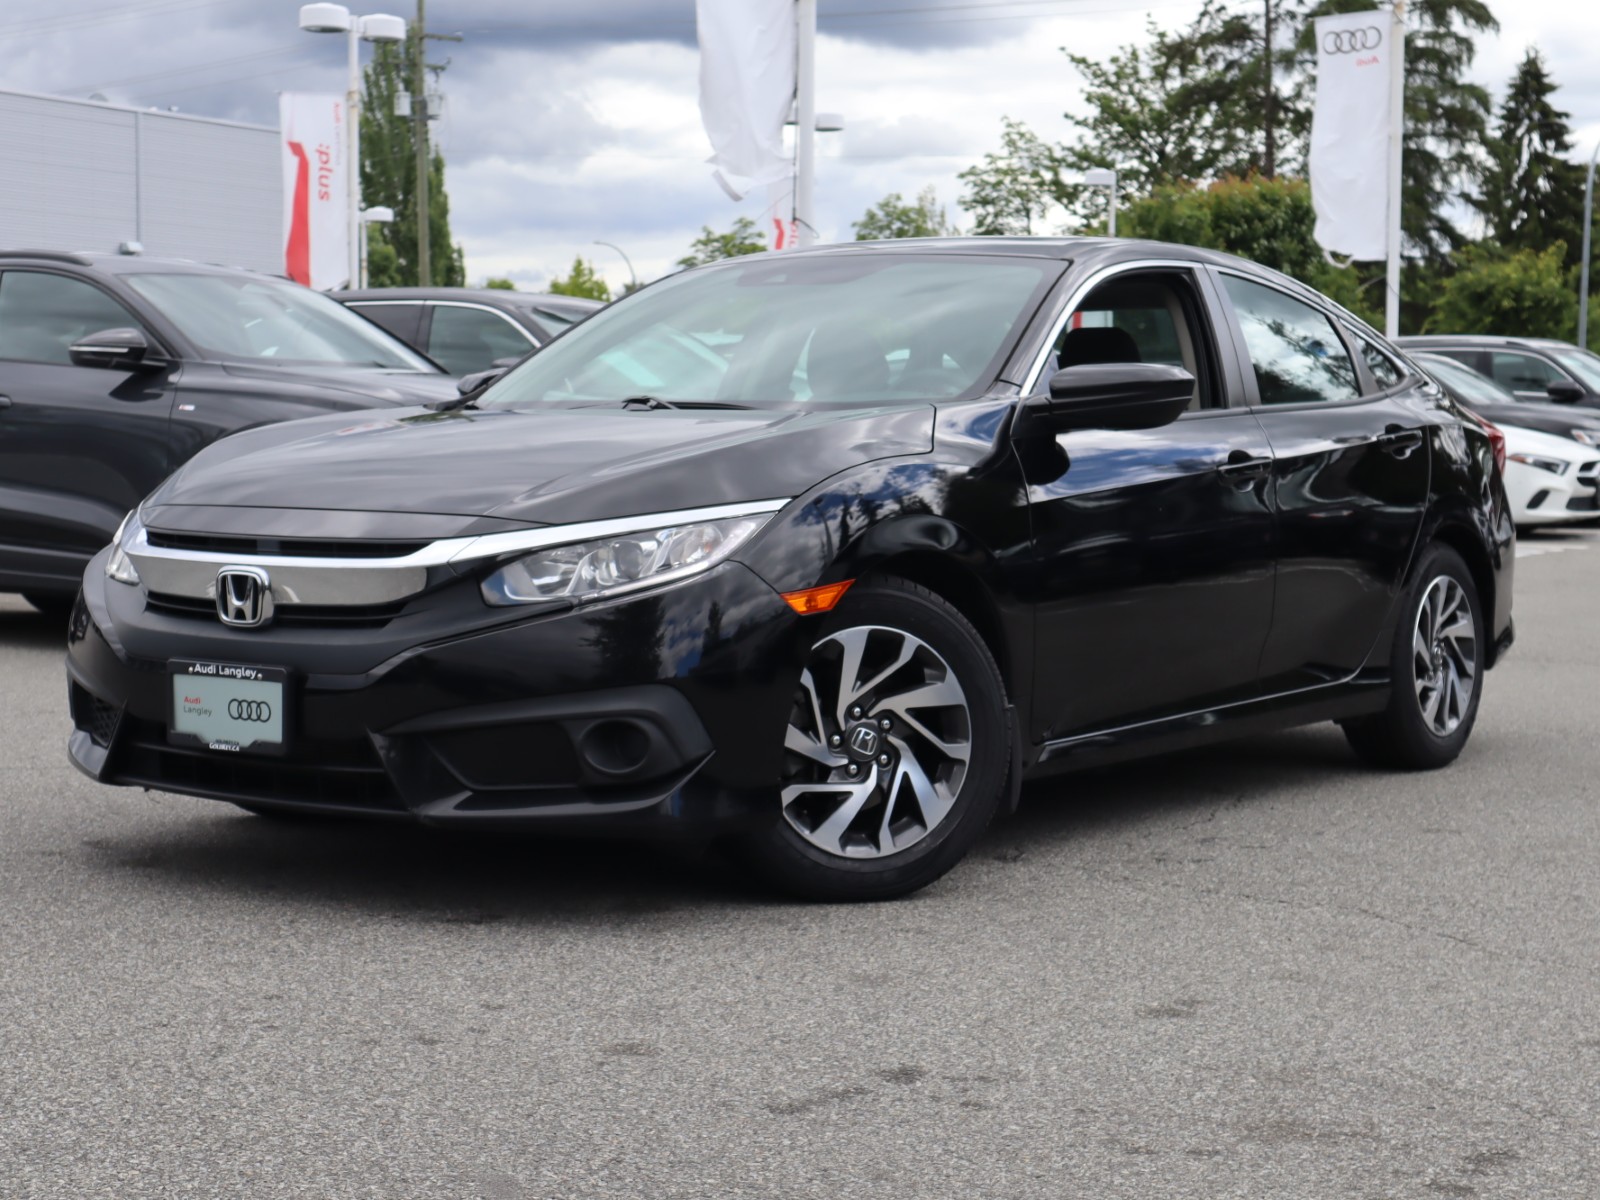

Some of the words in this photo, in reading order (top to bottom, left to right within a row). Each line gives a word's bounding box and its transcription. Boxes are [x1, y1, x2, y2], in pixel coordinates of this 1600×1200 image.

[194, 663, 216, 674] Audi
[219, 666, 257, 679] Langley
[184, 696, 201, 704] Audi
[183, 706, 212, 717] Langley
